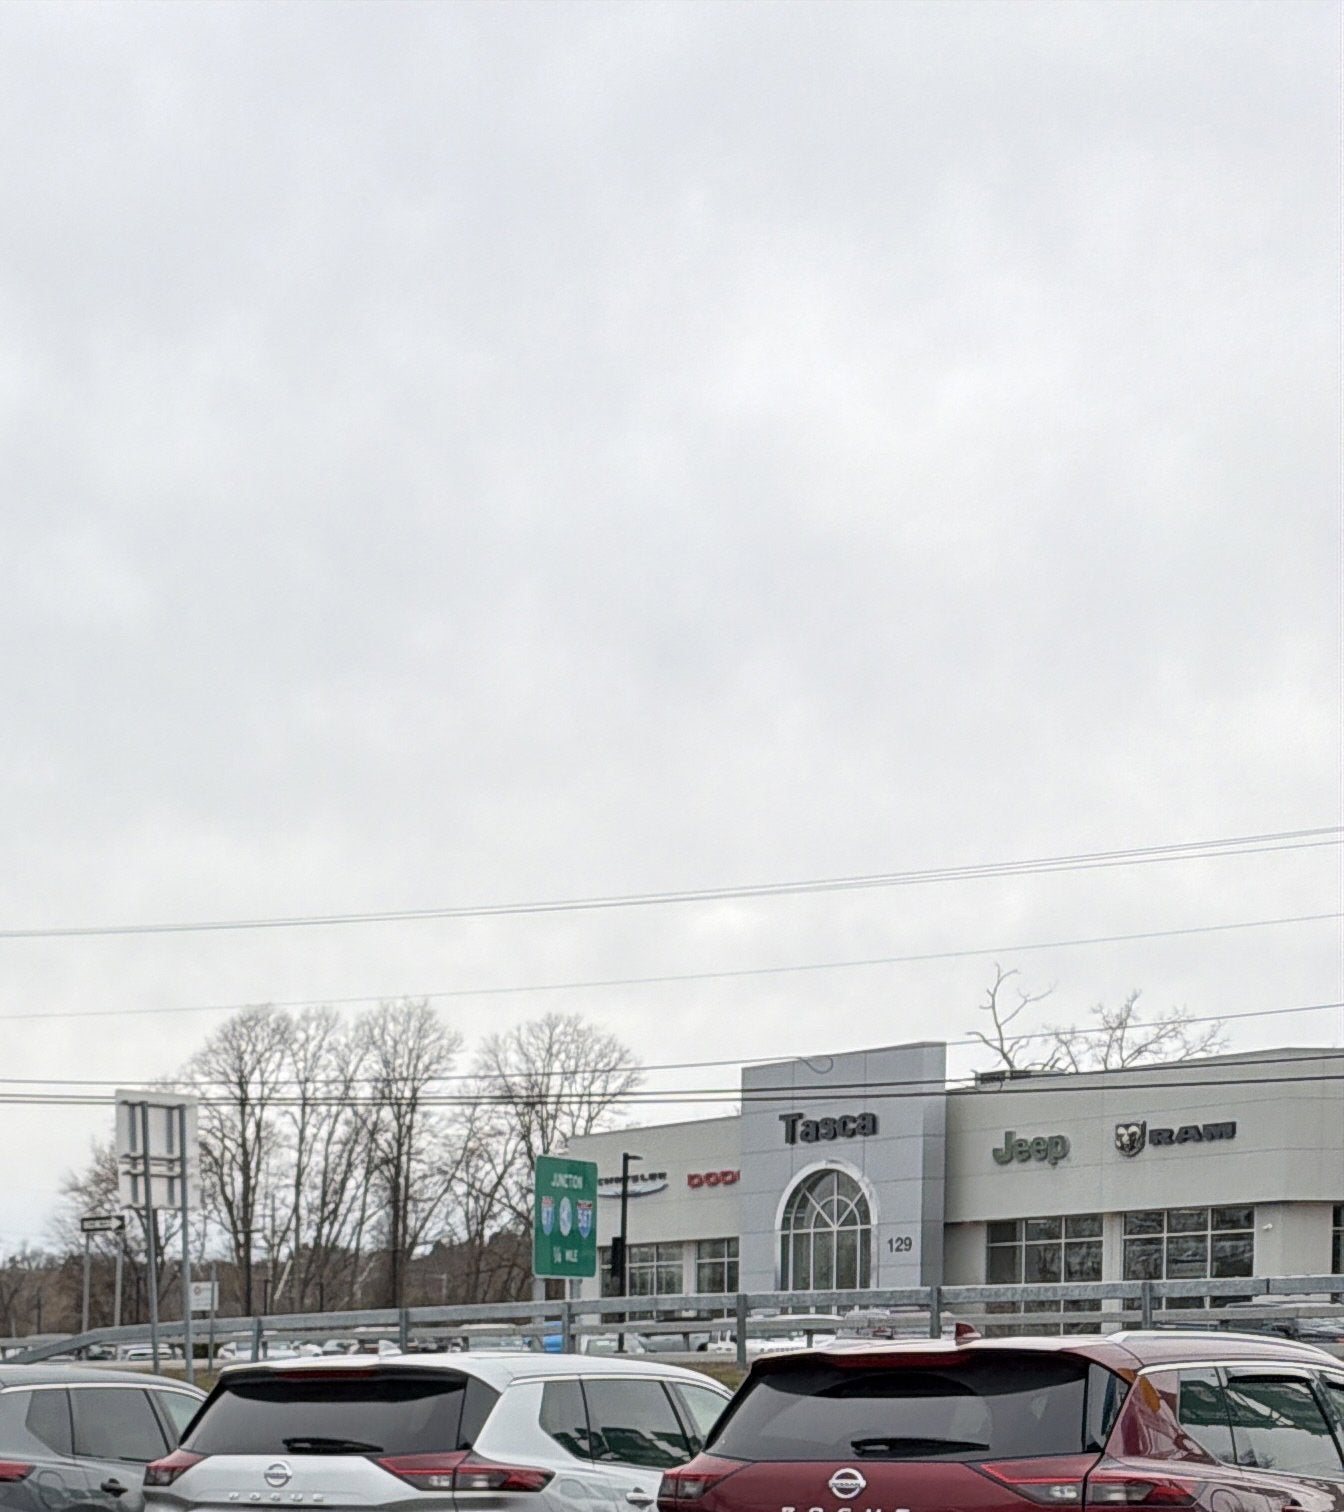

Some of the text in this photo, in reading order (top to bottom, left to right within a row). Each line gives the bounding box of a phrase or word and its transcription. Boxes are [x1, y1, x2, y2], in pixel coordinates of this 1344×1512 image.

[778, 1112, 878, 1146] Tasca
[1148, 1121, 1238, 1147] RAM
[992, 1121, 1071, 1168] Jeep
[687, 1169, 741, 1189] DOD
[887, 1236, 913, 1253] 129
